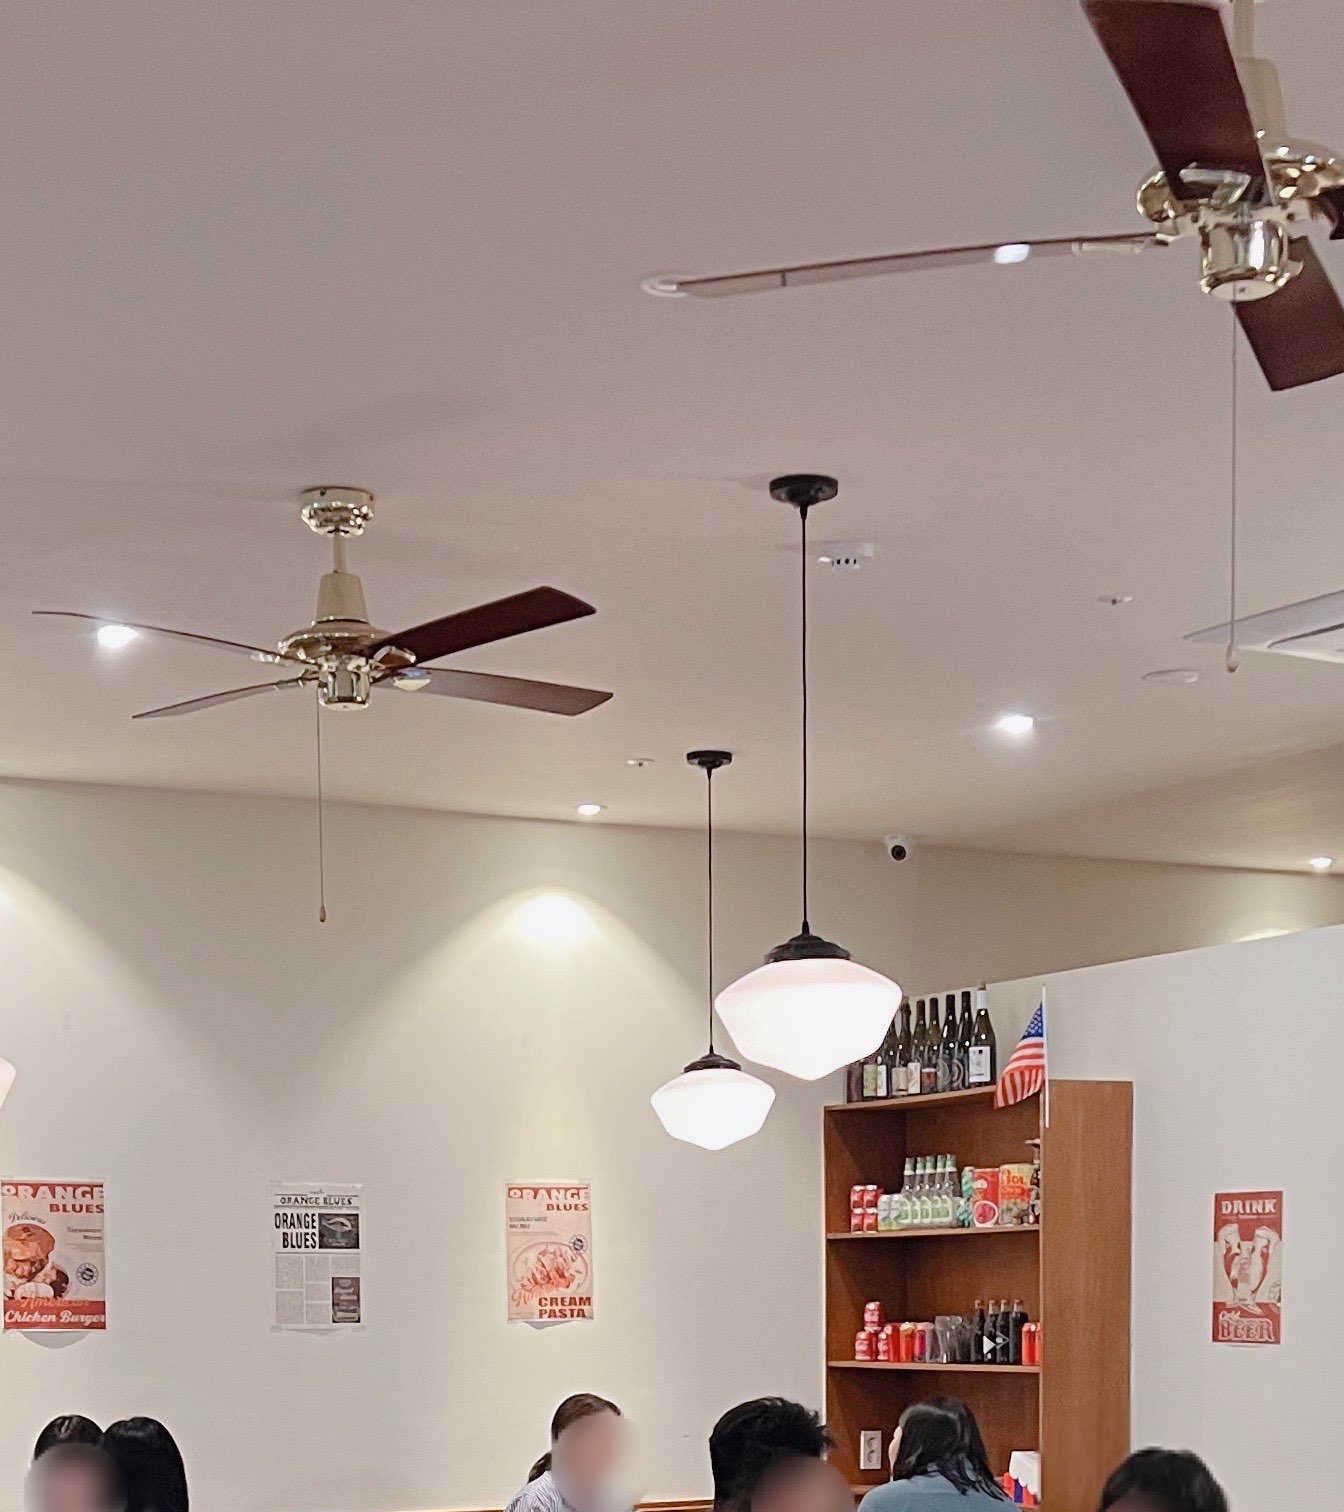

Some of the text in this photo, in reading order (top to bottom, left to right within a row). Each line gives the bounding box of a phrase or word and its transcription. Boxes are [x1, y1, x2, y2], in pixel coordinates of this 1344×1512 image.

[2, 1185, 104, 1200] ORANGE
[509, 1188, 590, 1200] ORANGE
[280, 1196, 321, 1205] ORANGE
[1221, 1199, 1276, 1214] DRINK
[49, 1203, 104, 1214] BLUES
[546, 1203, 589, 1212] BLUES
[274, 1212, 316, 1230] ORANGE
[282, 1231, 317, 1249] BLUES
[538, 1296, 592, 1307] CREAM
[4, 1309, 105, 1326] Chicken Burger
[538, 1308, 587, 1319] PASTA
